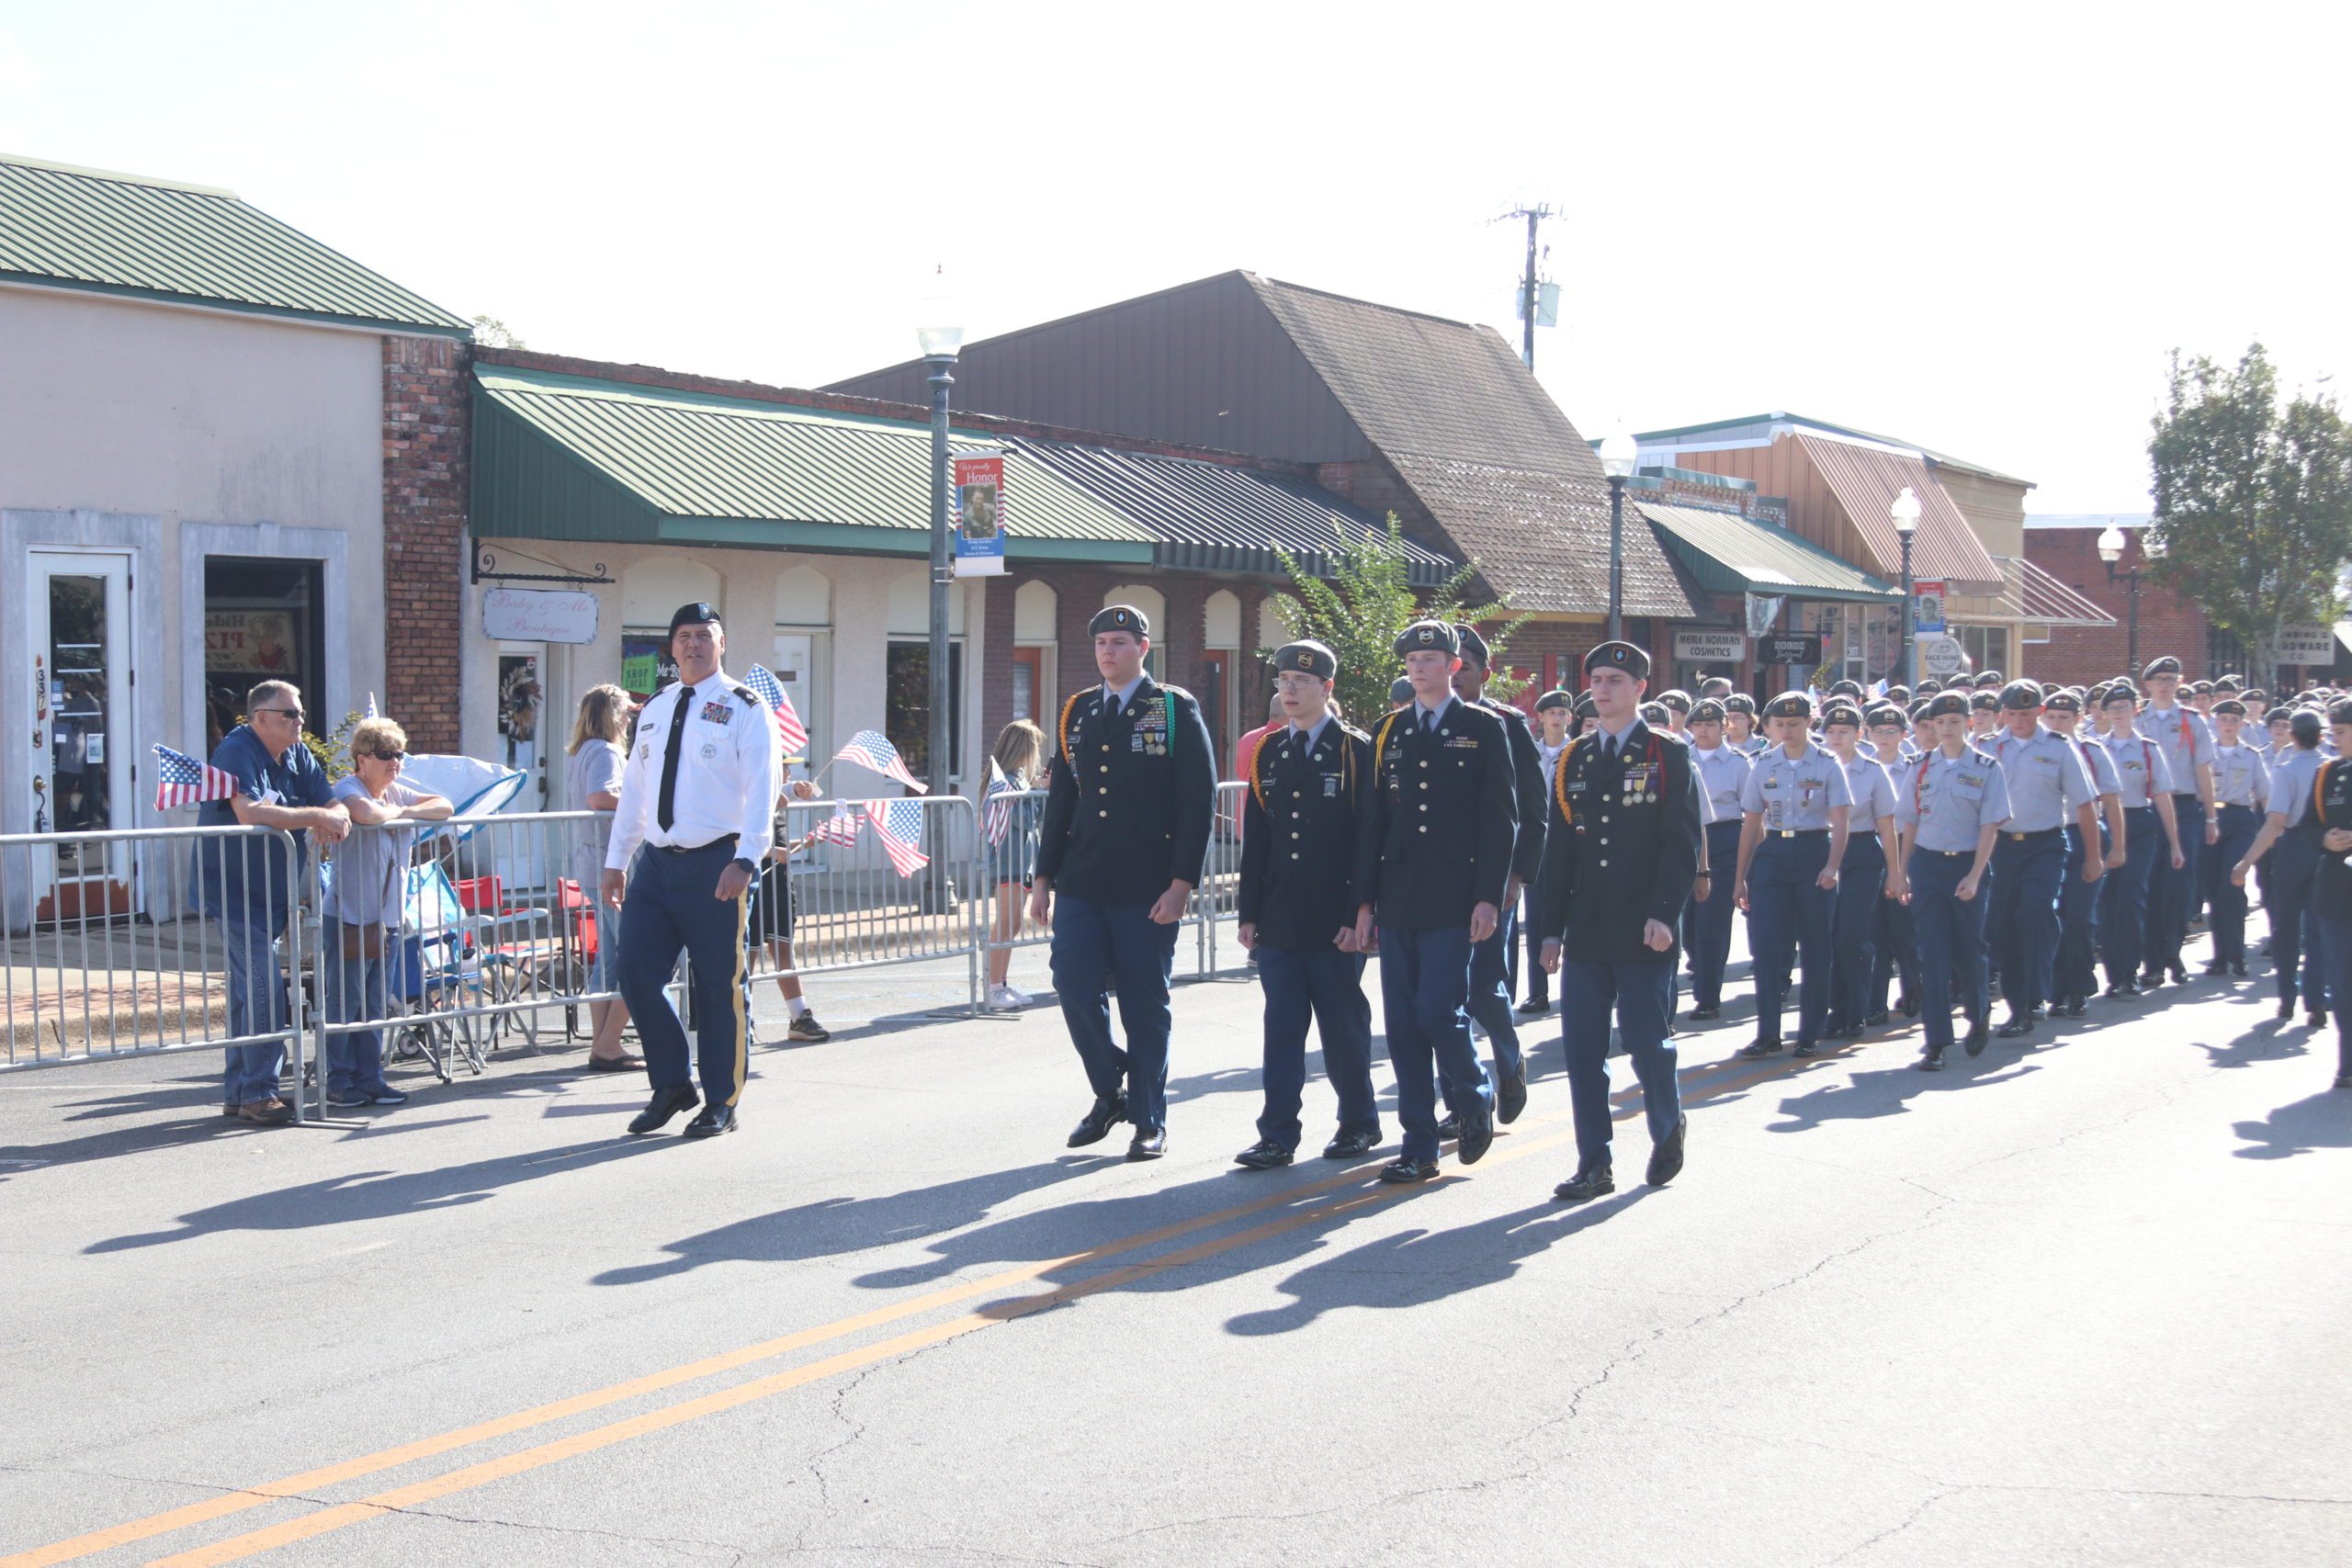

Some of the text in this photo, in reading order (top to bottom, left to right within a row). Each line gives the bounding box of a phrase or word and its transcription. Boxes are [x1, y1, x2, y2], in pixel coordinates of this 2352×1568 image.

[967, 472, 998, 482] Honor
[492, 592, 532, 614] Baby
[558, 599, 589, 613] Me
[507, 616, 571, 637] Boutique
[1679, 635, 1740, 646] MERLE NORMAN
[1690, 647, 1731, 657] COSMETICS
[626, 669, 649, 679] SHOP
